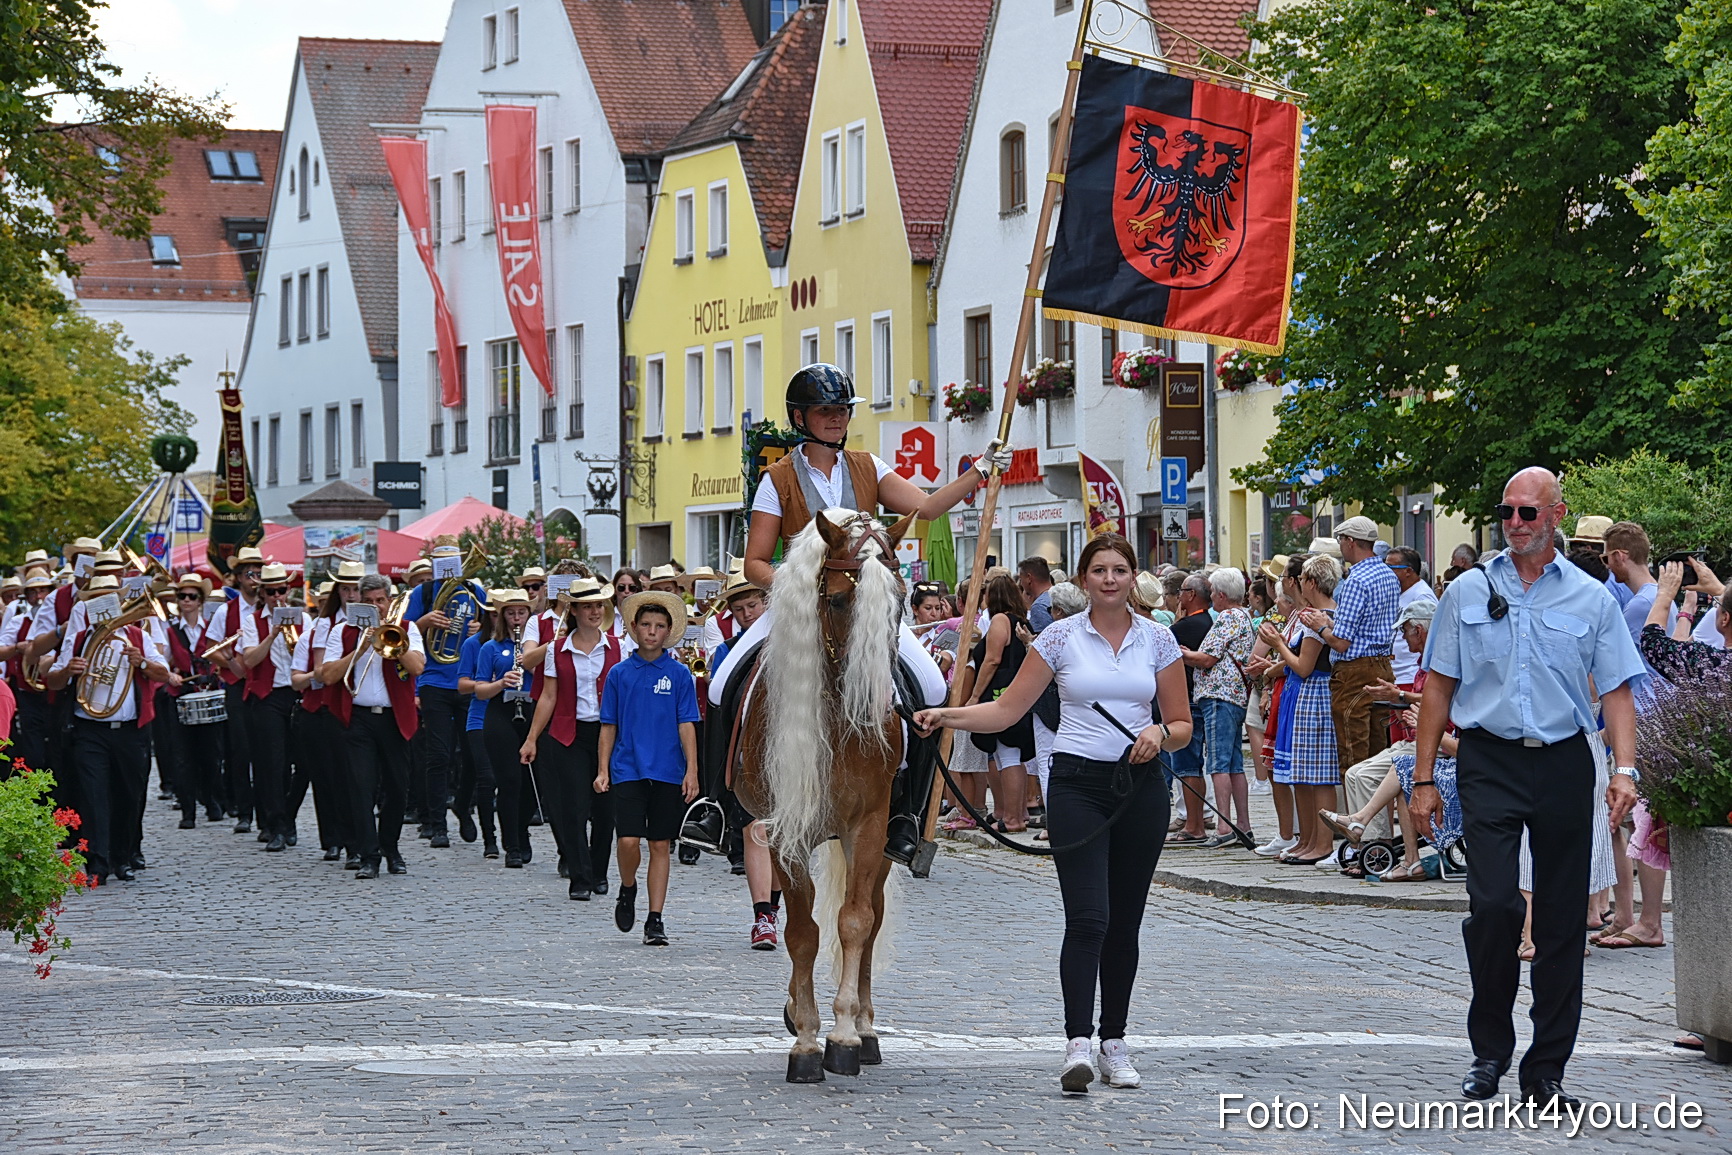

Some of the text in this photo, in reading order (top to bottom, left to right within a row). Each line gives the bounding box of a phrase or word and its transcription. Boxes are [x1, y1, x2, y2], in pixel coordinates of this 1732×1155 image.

[694, 293, 778, 335] HOTEL Lehmeier
[377, 481, 419, 490] SCHMID
[691, 472, 741, 498] Restaurant
[1087, 481, 1117, 503] EIS
[1167, 464, 1181, 499] P
[1269, 490, 1291, 509] WOLLE
[1017, 507, 1063, 522] RATHAUS APOTHEKE
